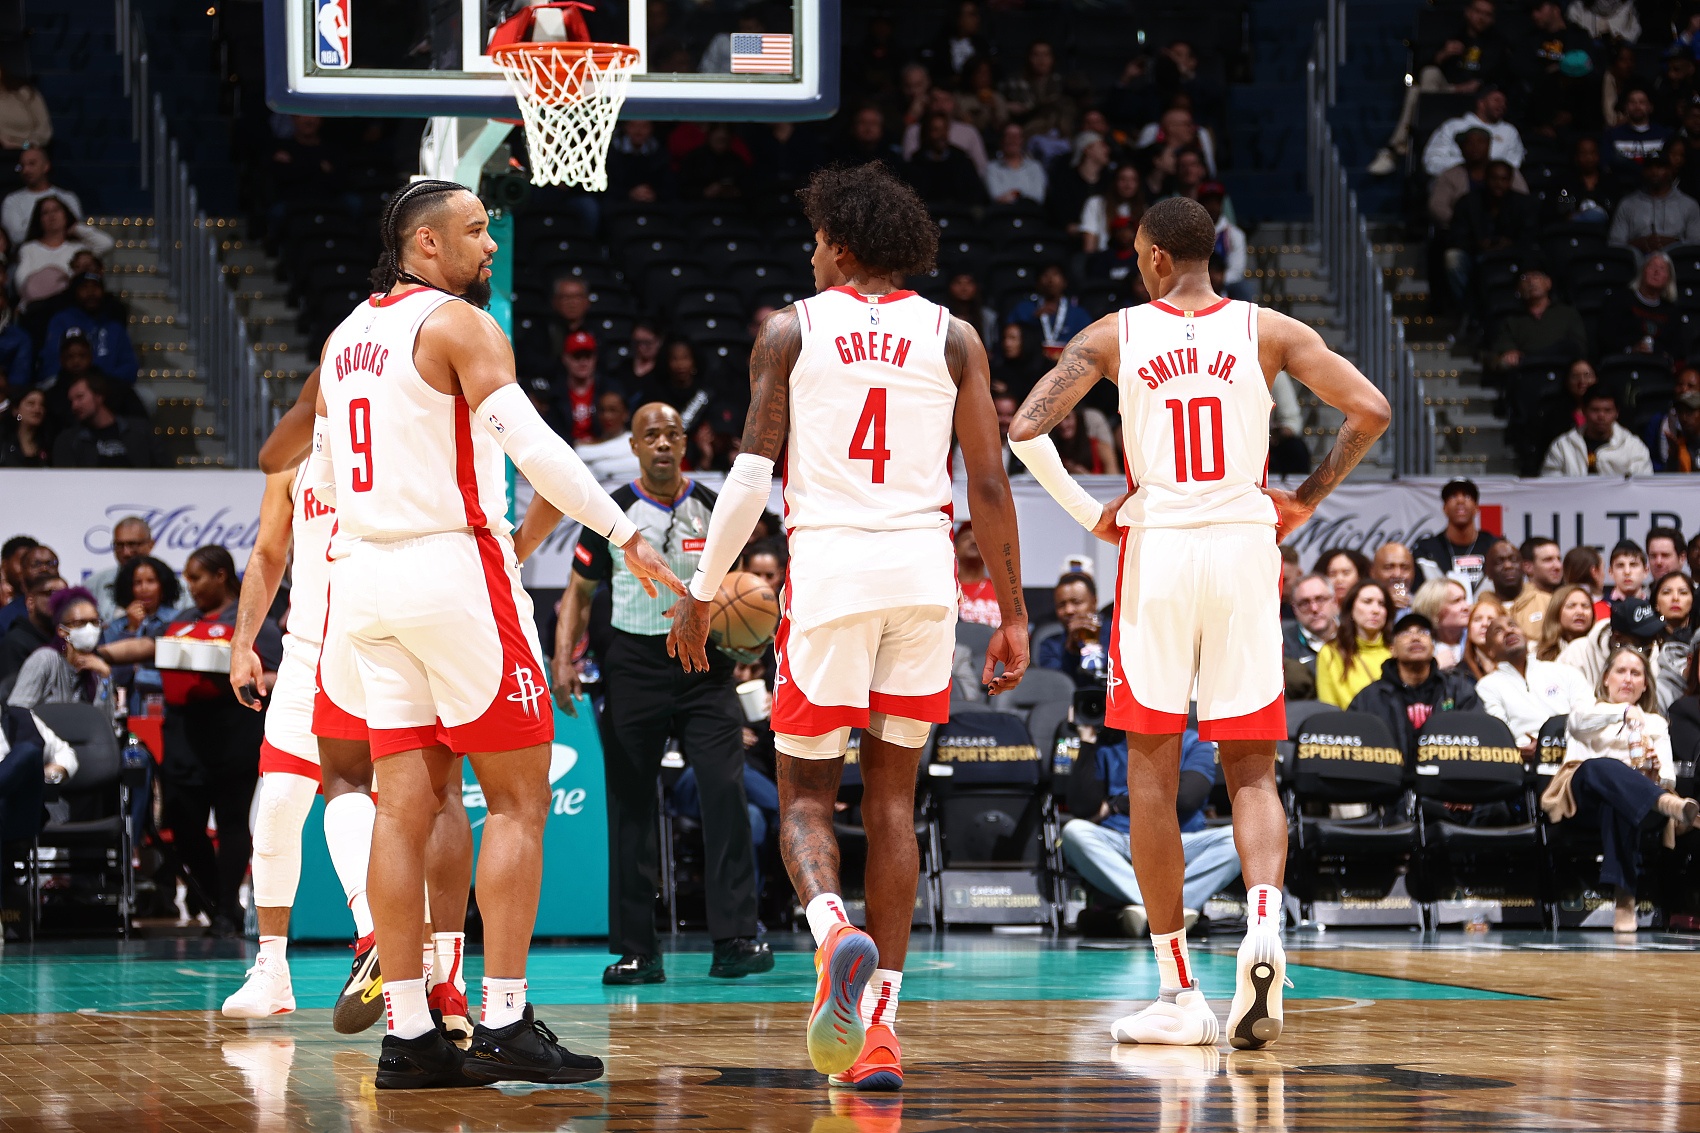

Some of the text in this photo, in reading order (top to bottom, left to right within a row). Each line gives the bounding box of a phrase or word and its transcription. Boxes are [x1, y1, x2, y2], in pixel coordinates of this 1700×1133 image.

[321, 50, 339, 64] NBA
[335, 341, 389, 382] BROOKS
[835, 331, 911, 368] GREEN
[1137, 347, 1237, 390] SMITH JR.
[349, 397, 374, 493] 9
[848, 387, 891, 484] 4
[1165, 396, 1226, 483] 10
[938, 736, 997, 747] CAESARS
[1299, 732, 1362, 747] CAESARS
[1417, 746, 1524, 764] SPORTSBOOK
[1418, 734, 1480, 747] CAESARS
